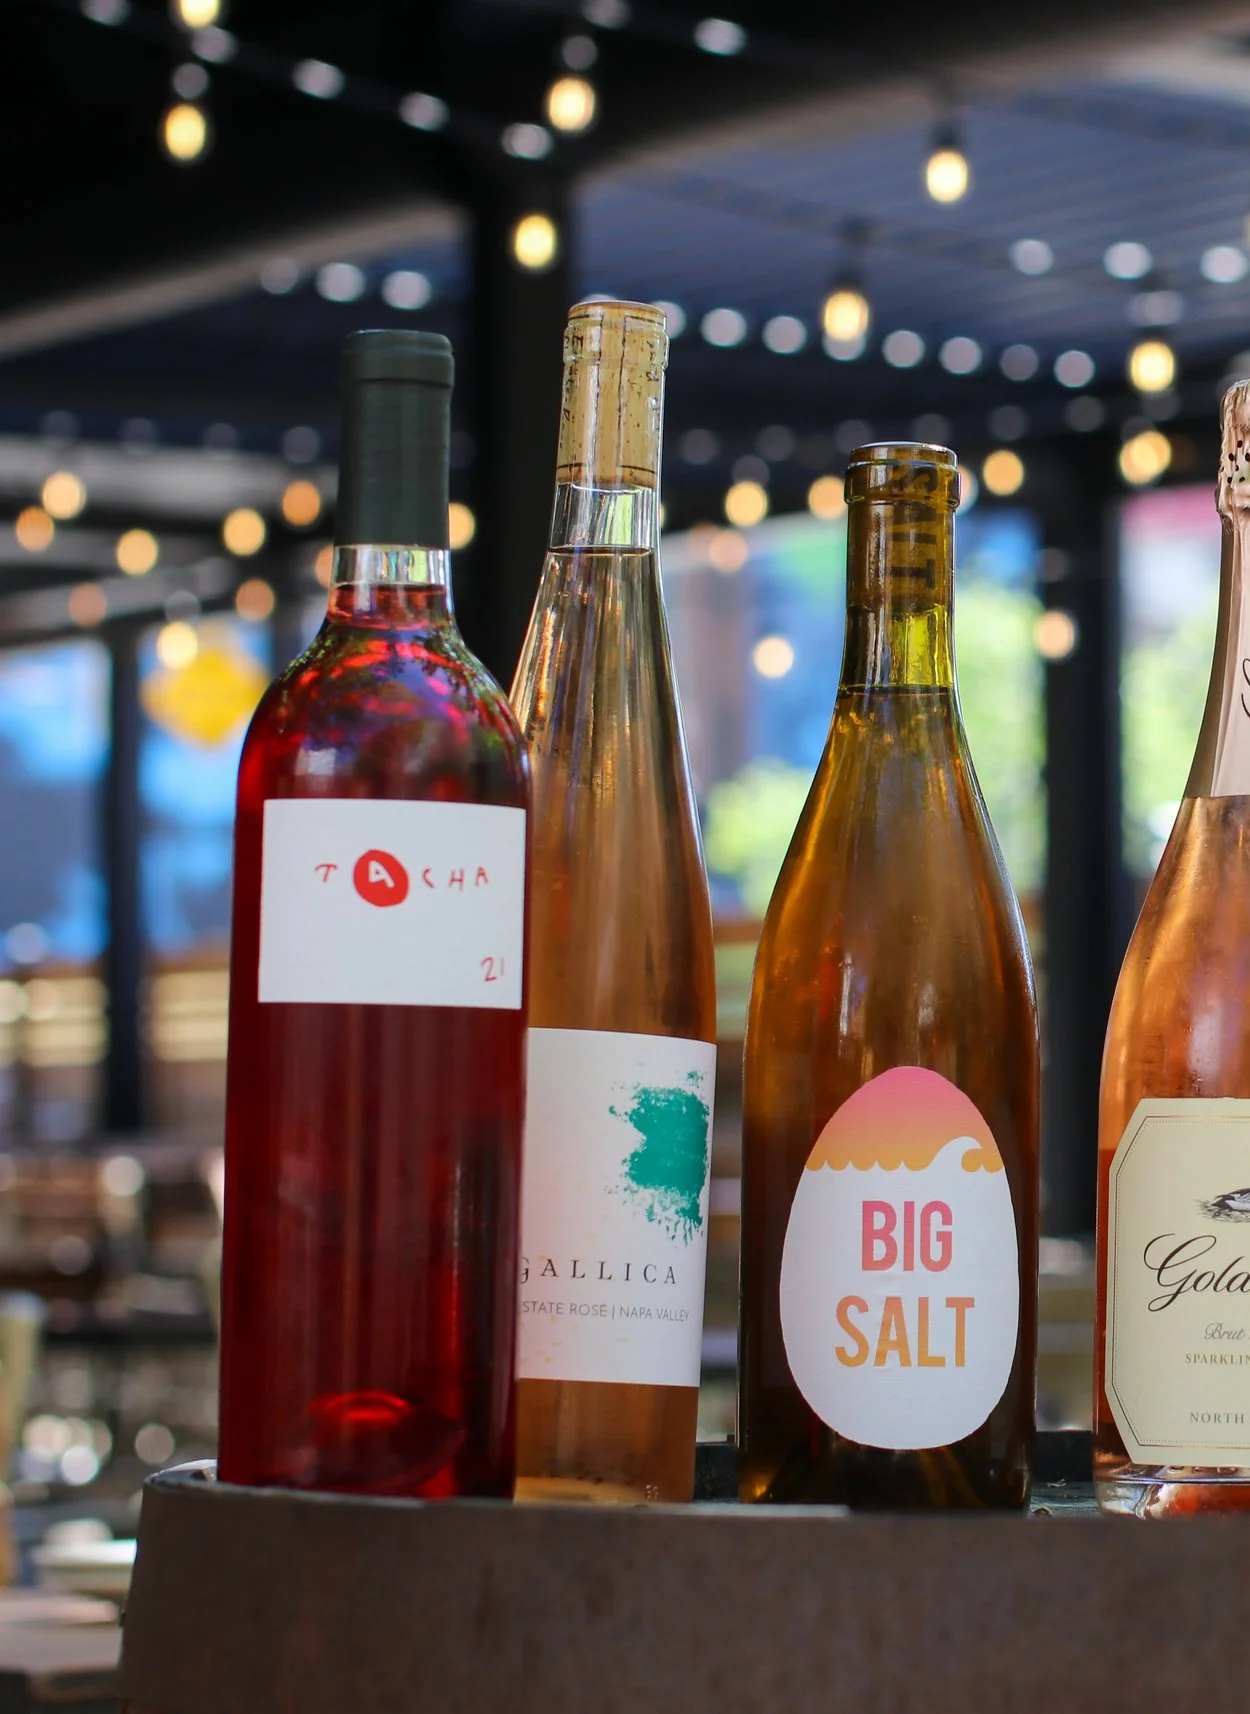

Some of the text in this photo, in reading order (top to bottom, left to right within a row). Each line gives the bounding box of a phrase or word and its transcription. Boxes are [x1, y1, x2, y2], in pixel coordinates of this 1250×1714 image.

[315, 856, 490, 896] TACHA
[481, 957, 505, 982] 21
[861, 1200, 953, 1272] BIG
[522, 1301, 690, 1322] STATE ROSÉ NAPA VALLEY
[835, 1295, 975, 1367] SALT
[1204, 1322, 1245, 1340] Brut
[1190, 1412, 1244, 1424] NORTH
